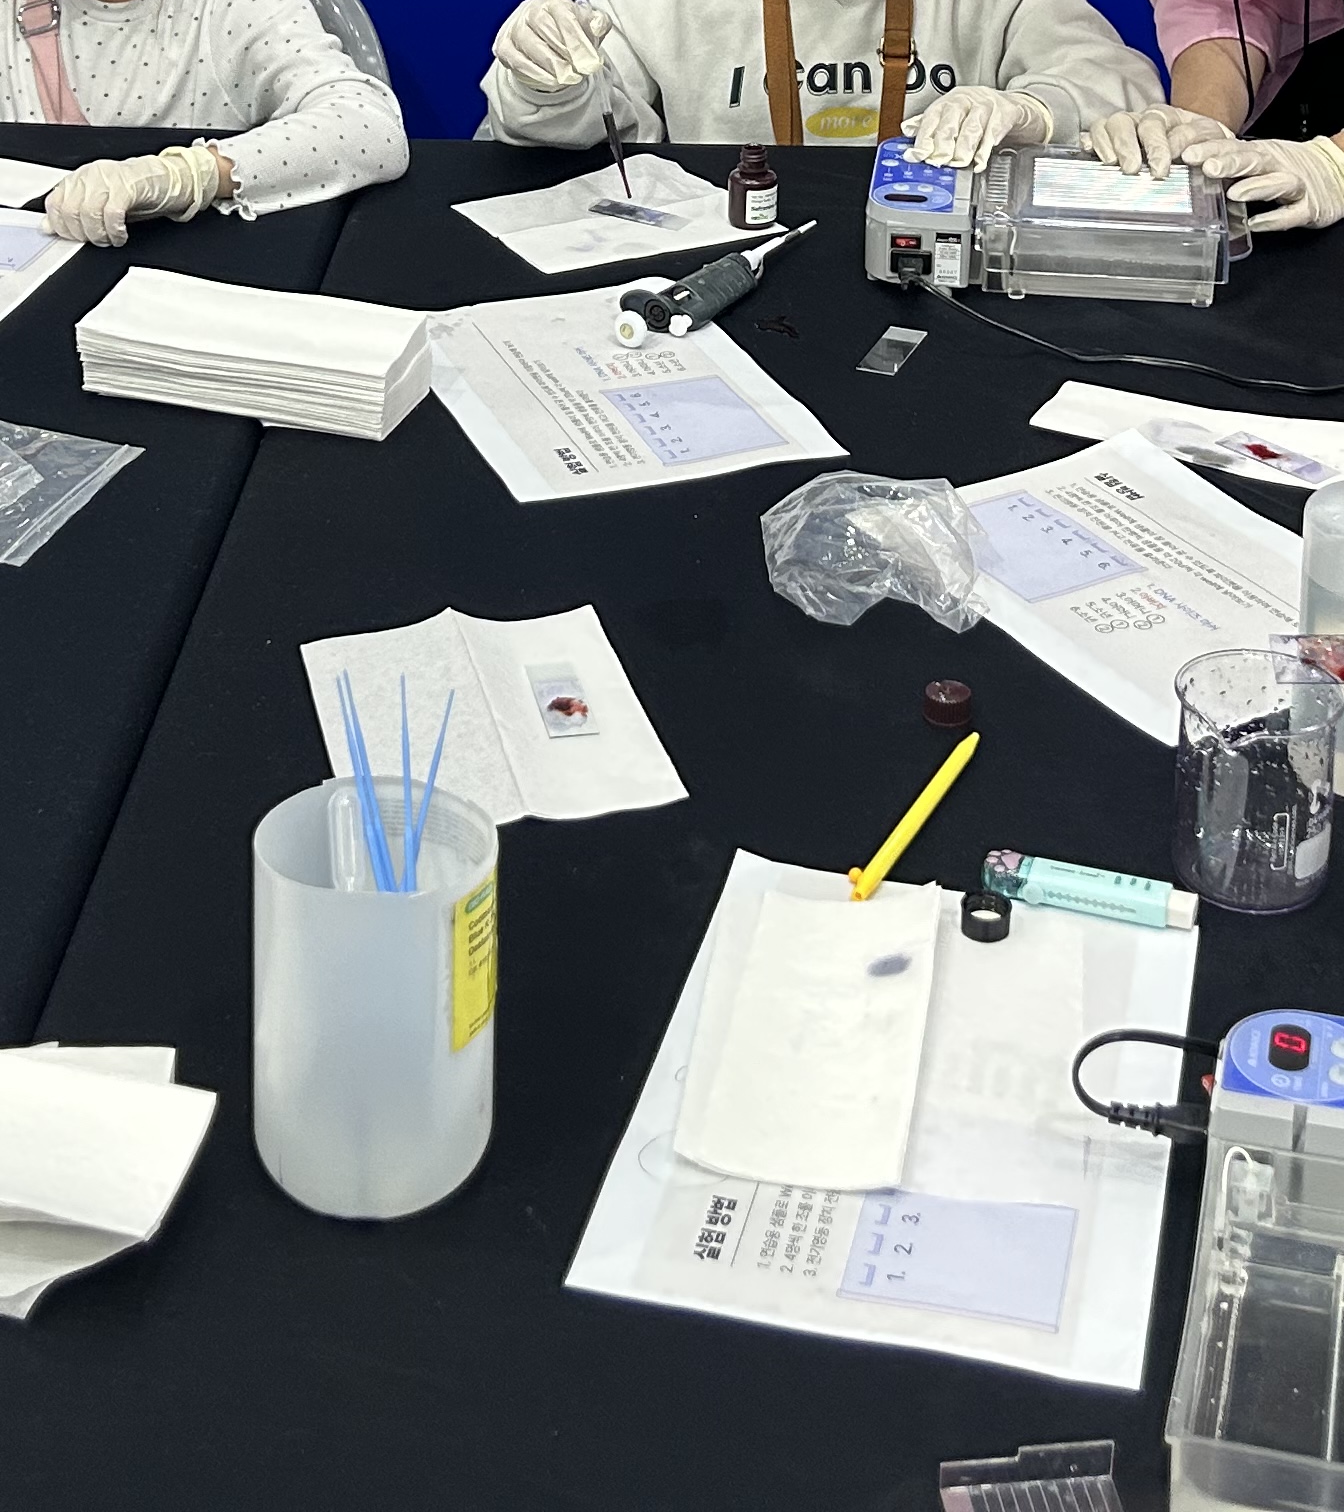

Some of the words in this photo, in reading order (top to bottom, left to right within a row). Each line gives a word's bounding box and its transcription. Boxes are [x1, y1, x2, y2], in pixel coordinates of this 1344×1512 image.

[729, 66, 745, 108] I
[820, 114, 873, 131] more
[1094, 472, 1123, 488] 실험
[1116, 485, 1145, 501] 방법
[705, 1195, 738, 1226] 방법
[795, 1202, 813, 1221] 조를
[902, 1212, 921, 1227] 3.
[694, 1228, 727, 1260] 실험
[760, 1230, 781, 1258] 연습용
[806, 1228, 830, 1265] 전기영동
[818, 1205, 836, 1225] 장치
[894, 1242, 914, 1256] 2.
[887, 1271, 906, 1282] 1.
